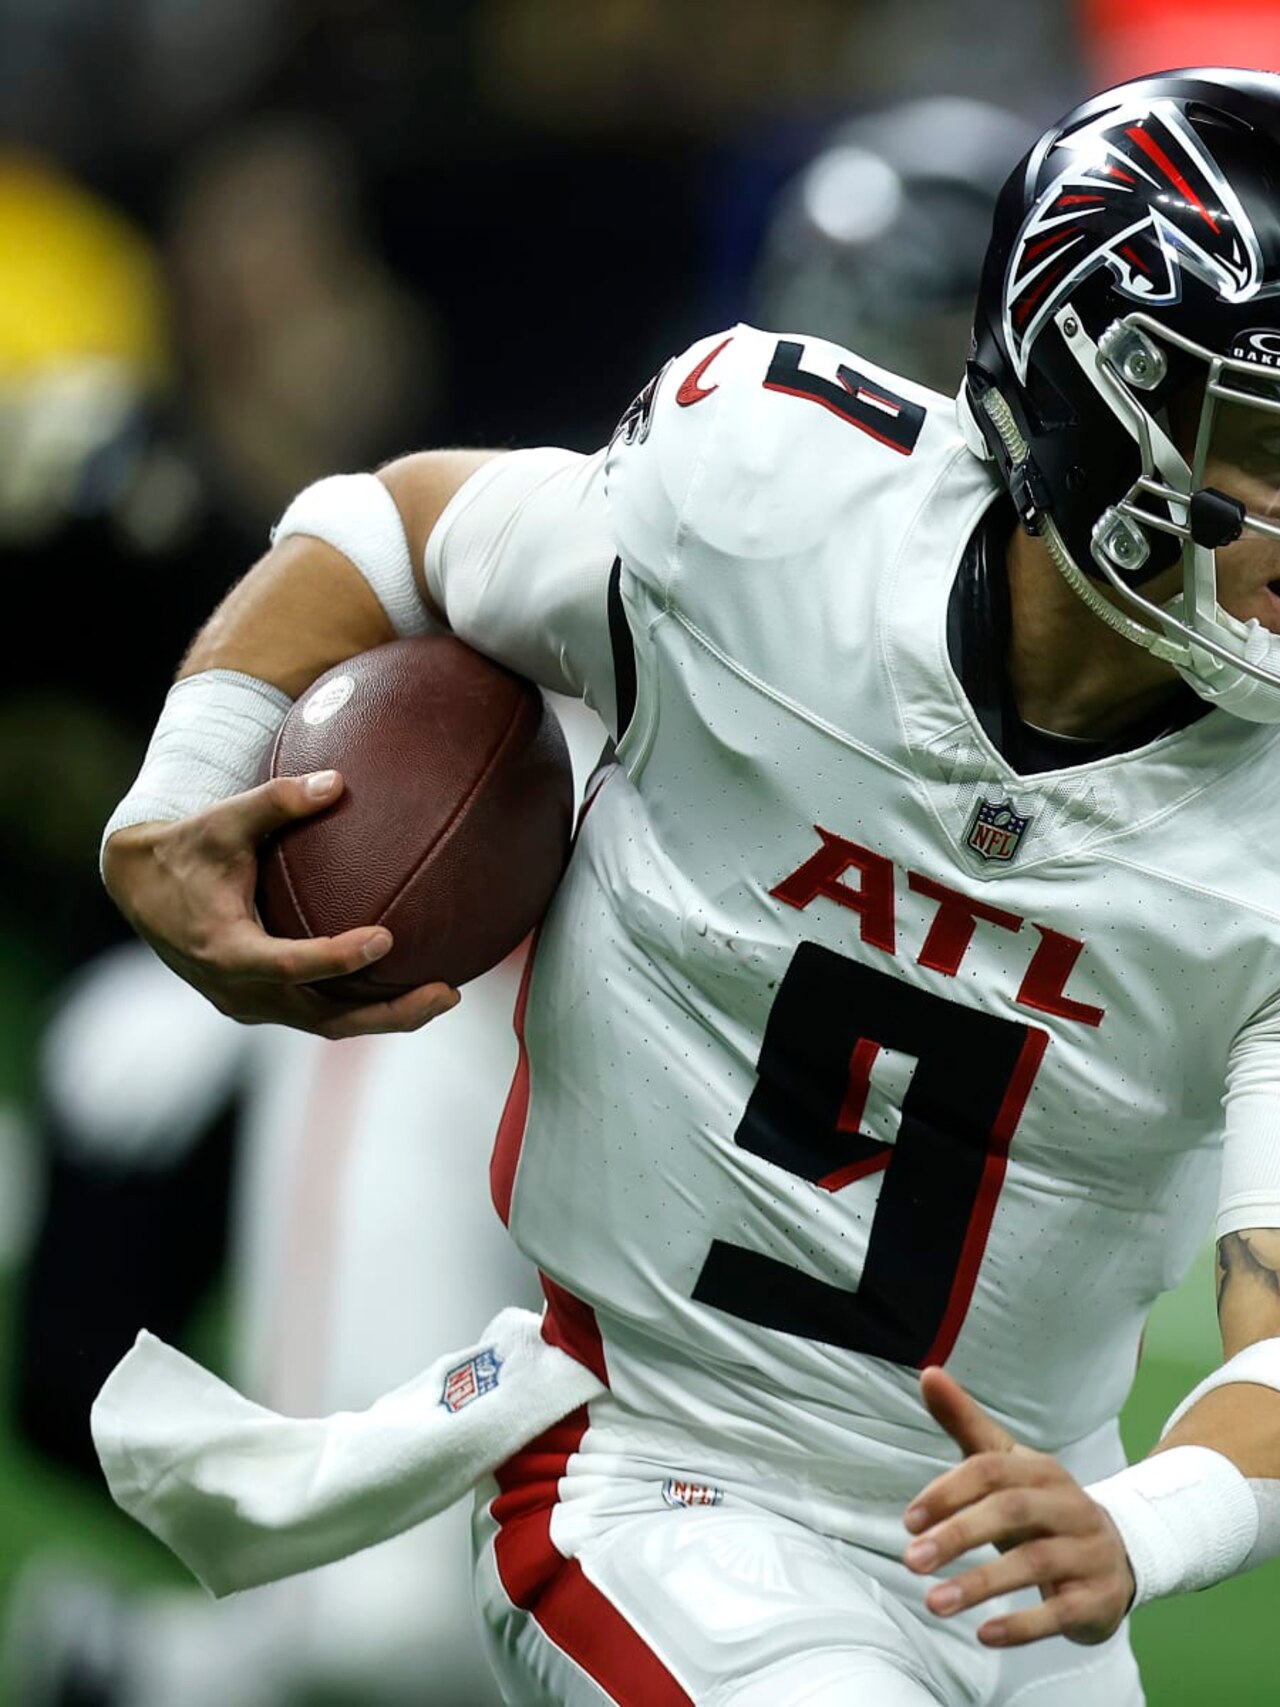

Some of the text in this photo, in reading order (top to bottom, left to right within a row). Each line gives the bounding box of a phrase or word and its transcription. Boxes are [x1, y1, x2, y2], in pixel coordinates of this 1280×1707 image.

[762, 339, 928, 457] 9
[972, 824, 1012, 857] NFL
[768, 825, 1105, 1028] ATL
[691, 940, 1050, 1370] 9
[674, 1480, 712, 1506] NFL
